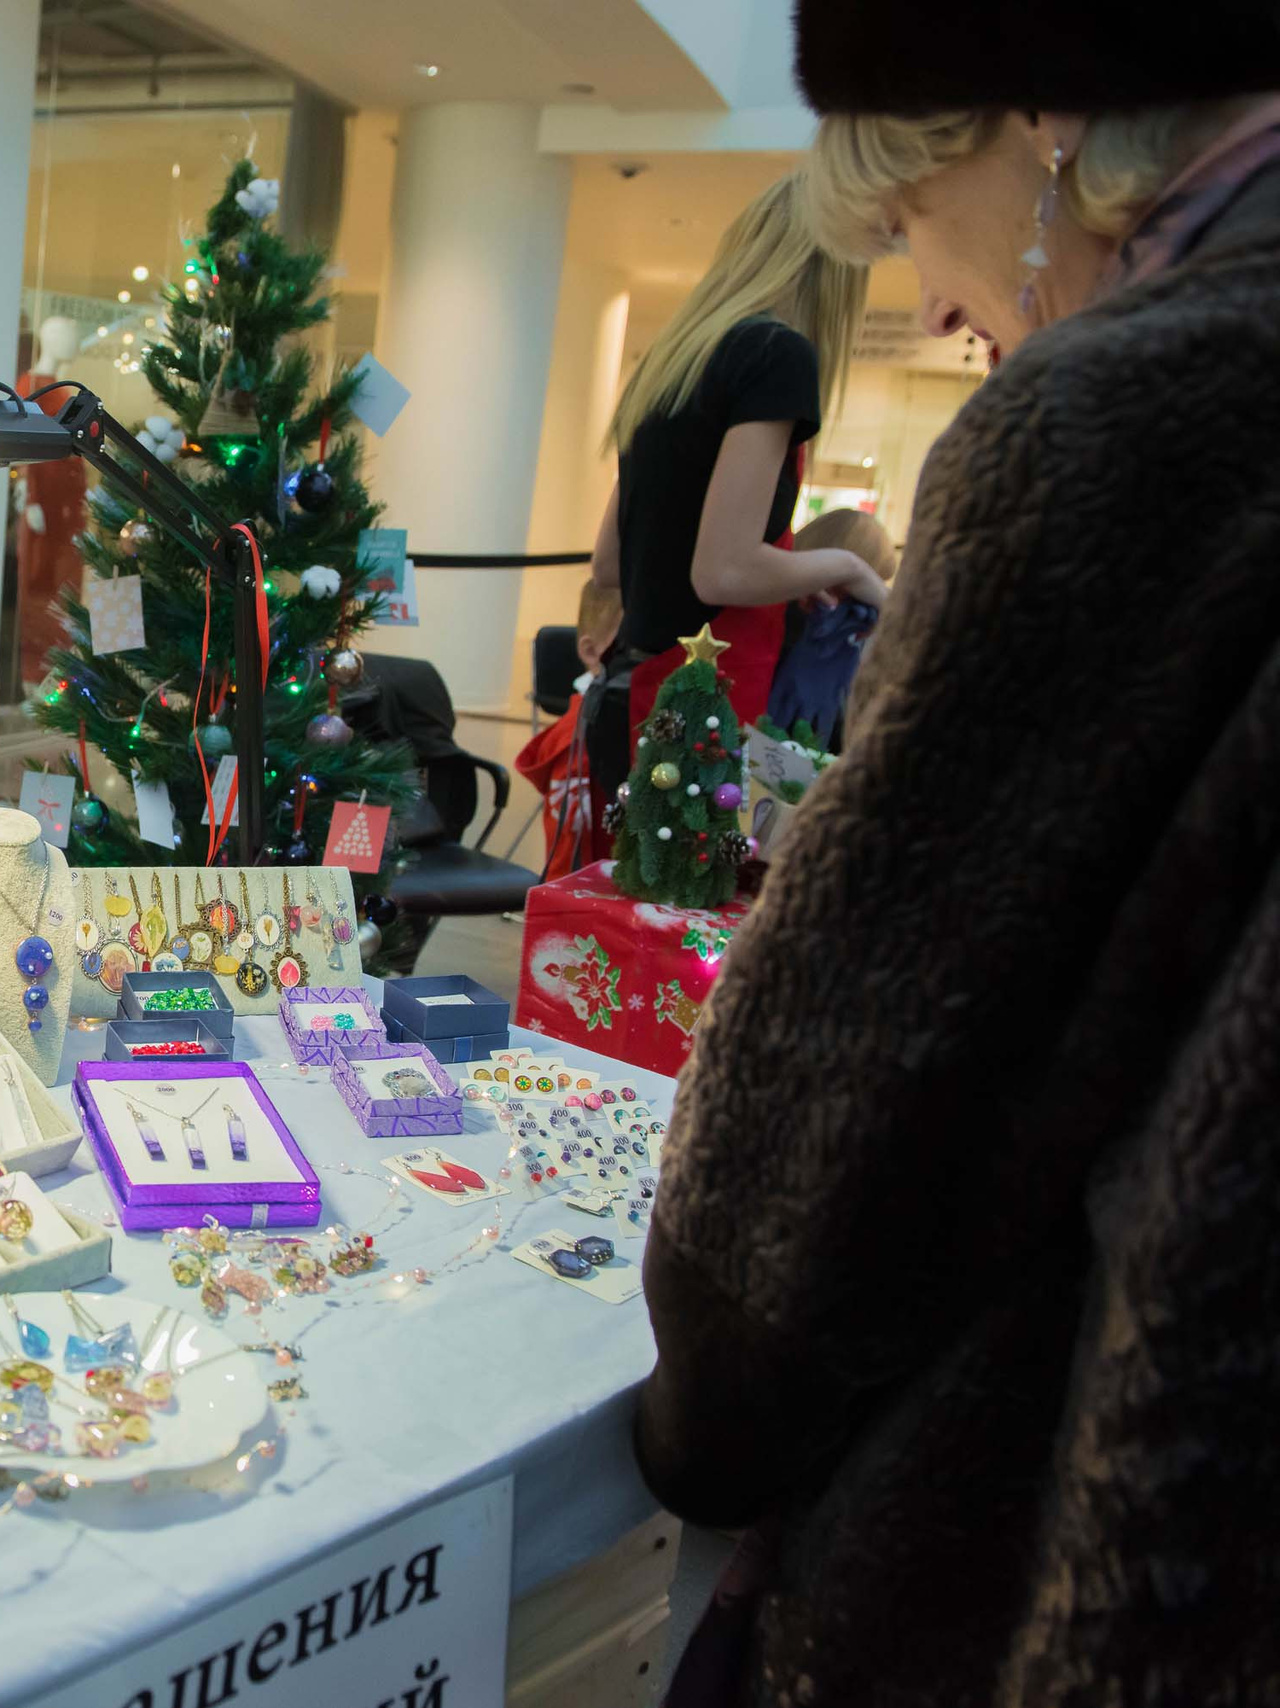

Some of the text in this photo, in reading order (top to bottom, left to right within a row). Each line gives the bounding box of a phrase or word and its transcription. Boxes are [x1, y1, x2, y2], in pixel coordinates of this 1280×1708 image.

[48, 909, 63, 921] 1200
[508, 1103, 523, 1111] 300
[552, 1109, 569, 1117] 400
[520, 1121, 537, 1129] 400
[577, 1129, 592, 1138] 400
[613, 1136, 630, 1146] 300
[563, 1143, 581, 1152] 400
[598, 1157, 616, 1166] 400
[527, 1162, 542, 1173] 300
[640, 1179, 657, 1188] 300
[630, 1200, 649, 1210] 400
